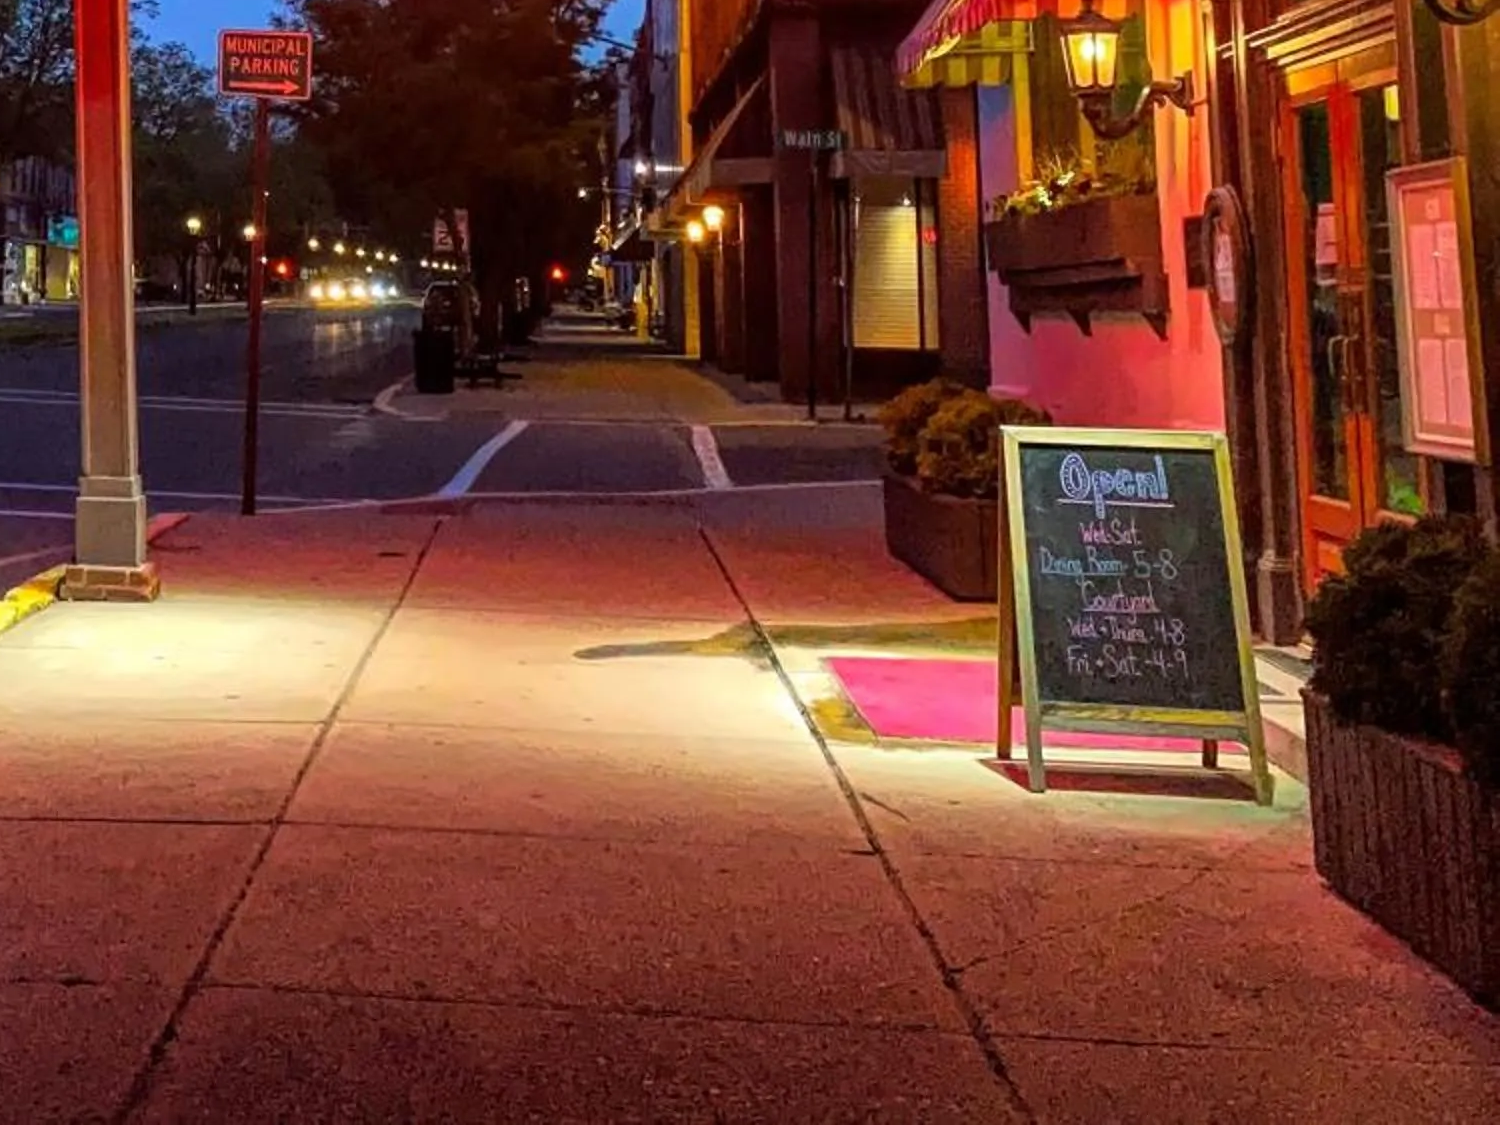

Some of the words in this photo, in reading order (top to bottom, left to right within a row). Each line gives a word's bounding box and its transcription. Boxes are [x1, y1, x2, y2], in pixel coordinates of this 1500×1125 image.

[225, 36, 306, 56] MUNICIPAL
[229, 56, 300, 76] PARKING
[1039, 546, 1084, 575] Dining
[1076, 577, 1161, 625] Courtyard
